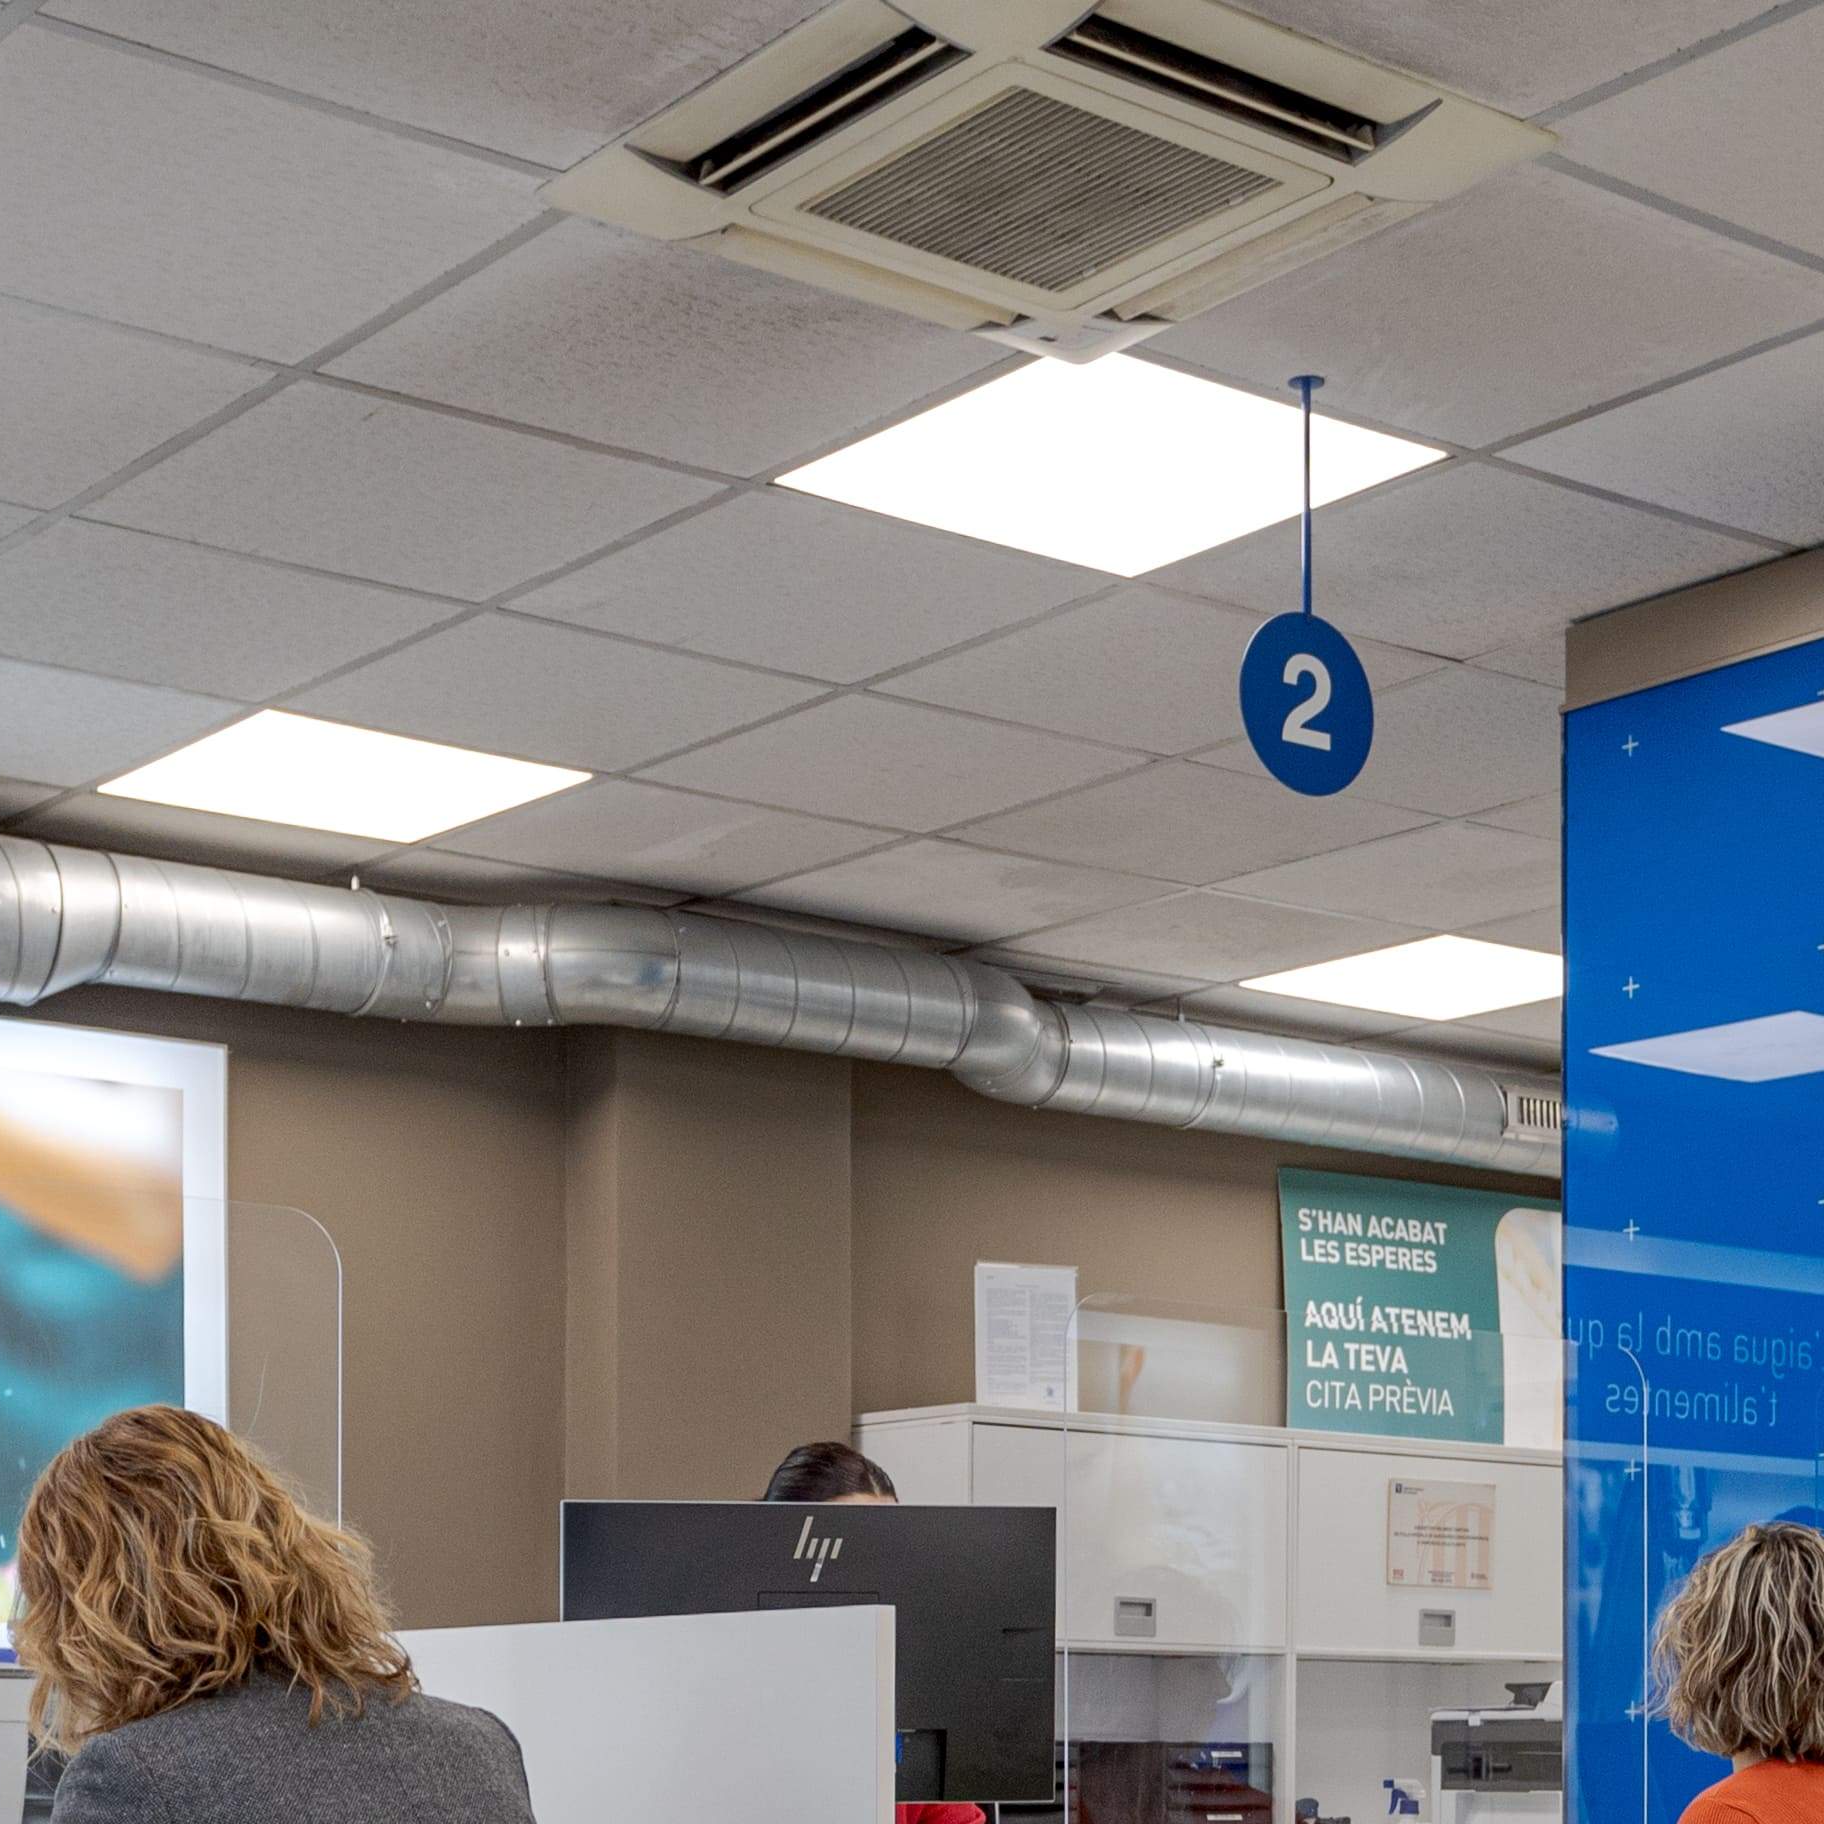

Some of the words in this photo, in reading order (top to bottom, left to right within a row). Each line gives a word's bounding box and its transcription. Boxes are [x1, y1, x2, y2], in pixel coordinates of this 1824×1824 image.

[1282, 653, 1331, 751] 2
[1298, 1208, 1363, 1237] S'HAN
[1368, 1215, 1447, 1245] ACABAT
[1301, 1238, 1340, 1264] LES
[1345, 1242, 1437, 1273] ESPERES
[1305, 1296, 1365, 1331] AQUÍ
[1371, 1305, 1472, 1340] ATENEM
[1306, 1340, 1339, 1369] LA
[1344, 1343, 1408, 1374] TEVA
[1306, 1380, 1362, 1410] CITA
[1369, 1379, 1454, 1416] PRÈVIA
[793, 1515, 843, 1582] hp
